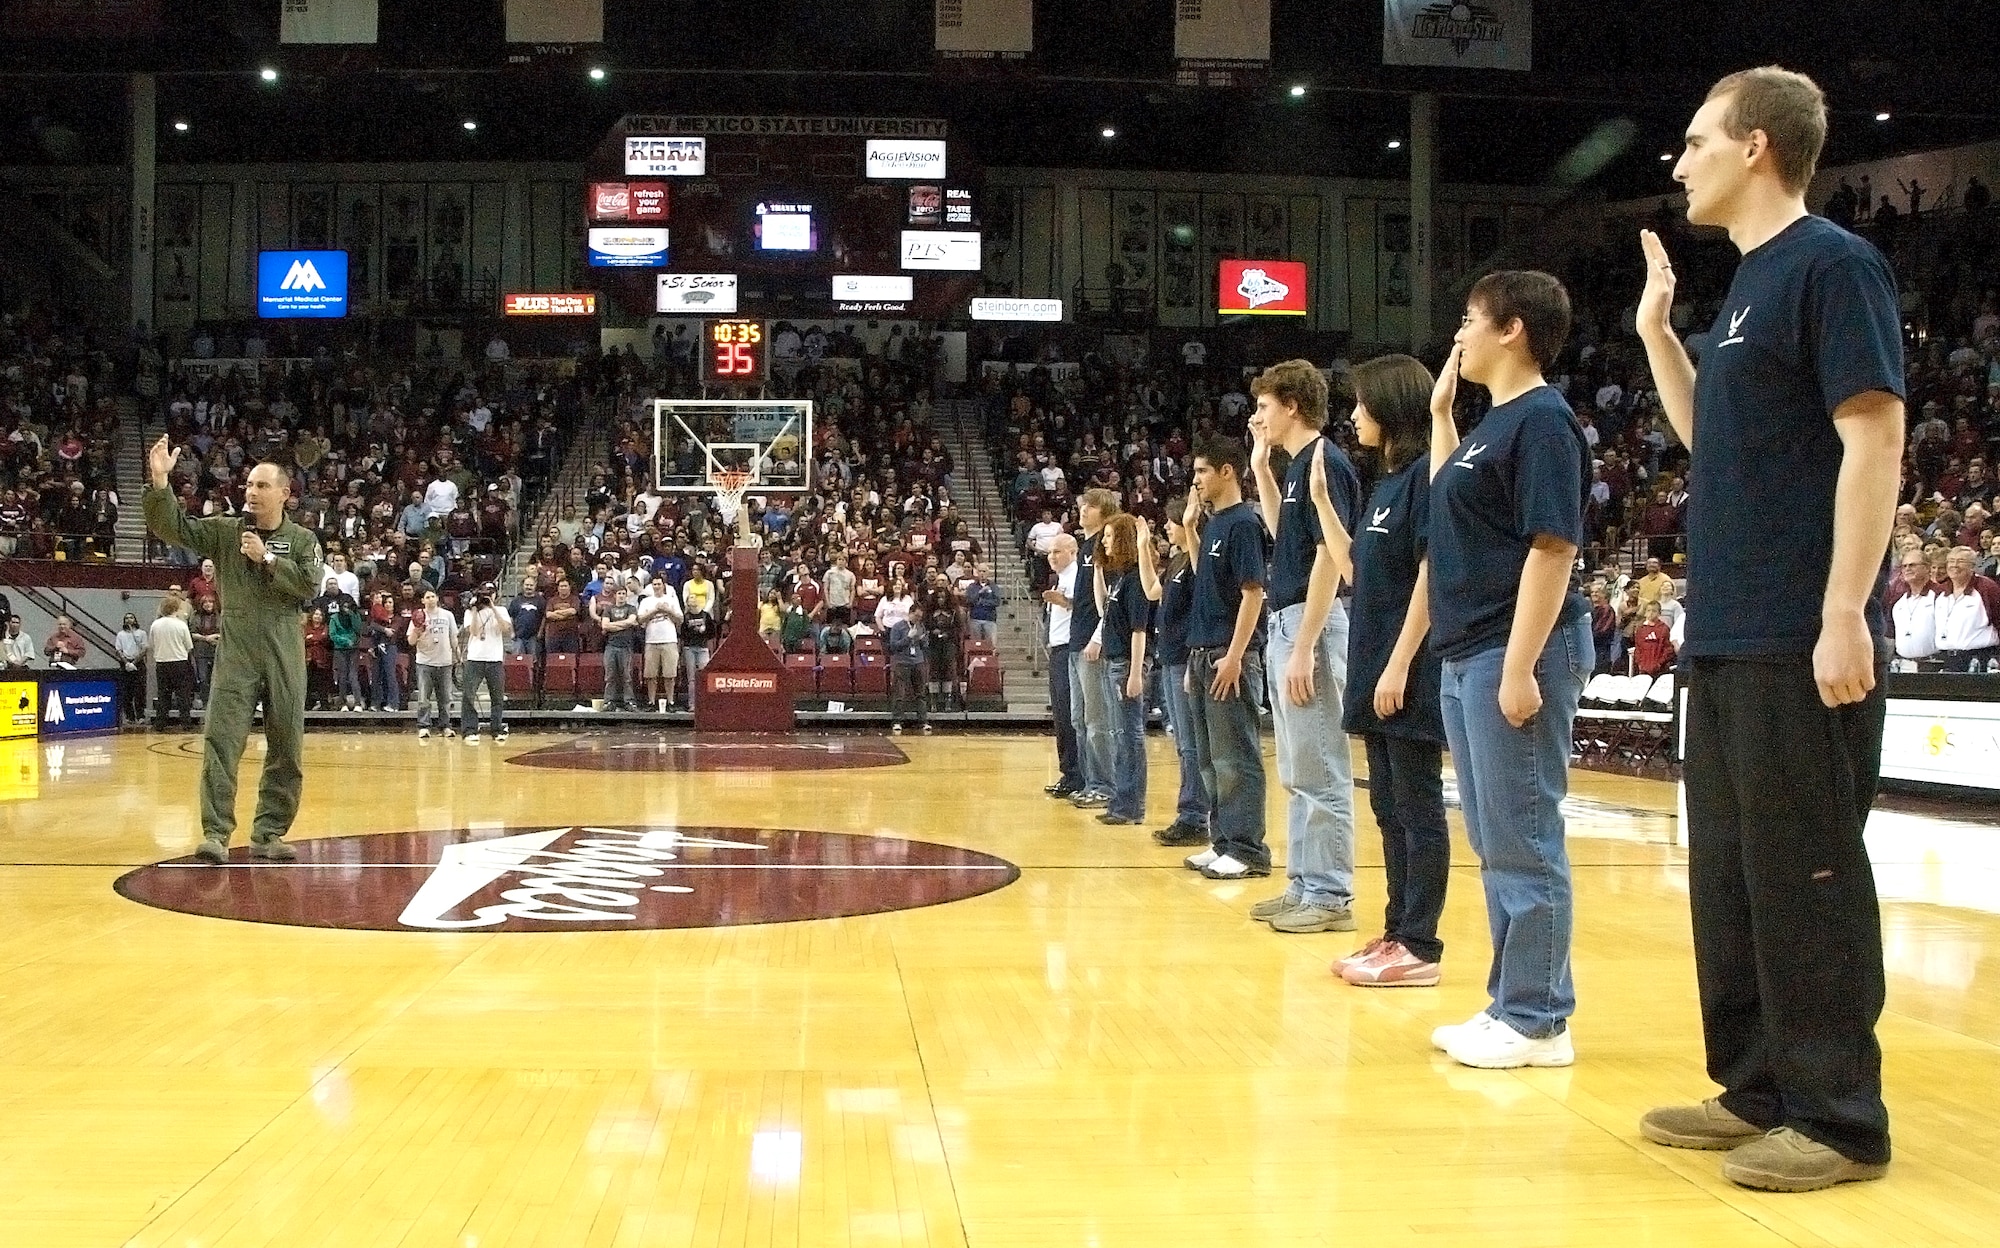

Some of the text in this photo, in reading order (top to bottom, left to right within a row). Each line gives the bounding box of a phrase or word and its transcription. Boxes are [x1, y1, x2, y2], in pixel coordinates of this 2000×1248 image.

[626, 116, 945, 135] NEW MEXICO STATE UNIVERSITY
[634, 189, 664, 199] refresh
[946, 190, 972, 199] REAL
[638, 199, 660, 208] your
[770, 204, 795, 212] THANK
[636, 207, 662, 216] game
[946, 205, 972, 214] TASTE
[550, 297, 582, 305] The One
[839, 303, 862, 312] Ready
[883, 303, 906, 311] Good.
[977, 301, 1058, 312] steinborn.com
[714, 323, 761, 343] 10:35
[717, 343, 754, 373] 35
